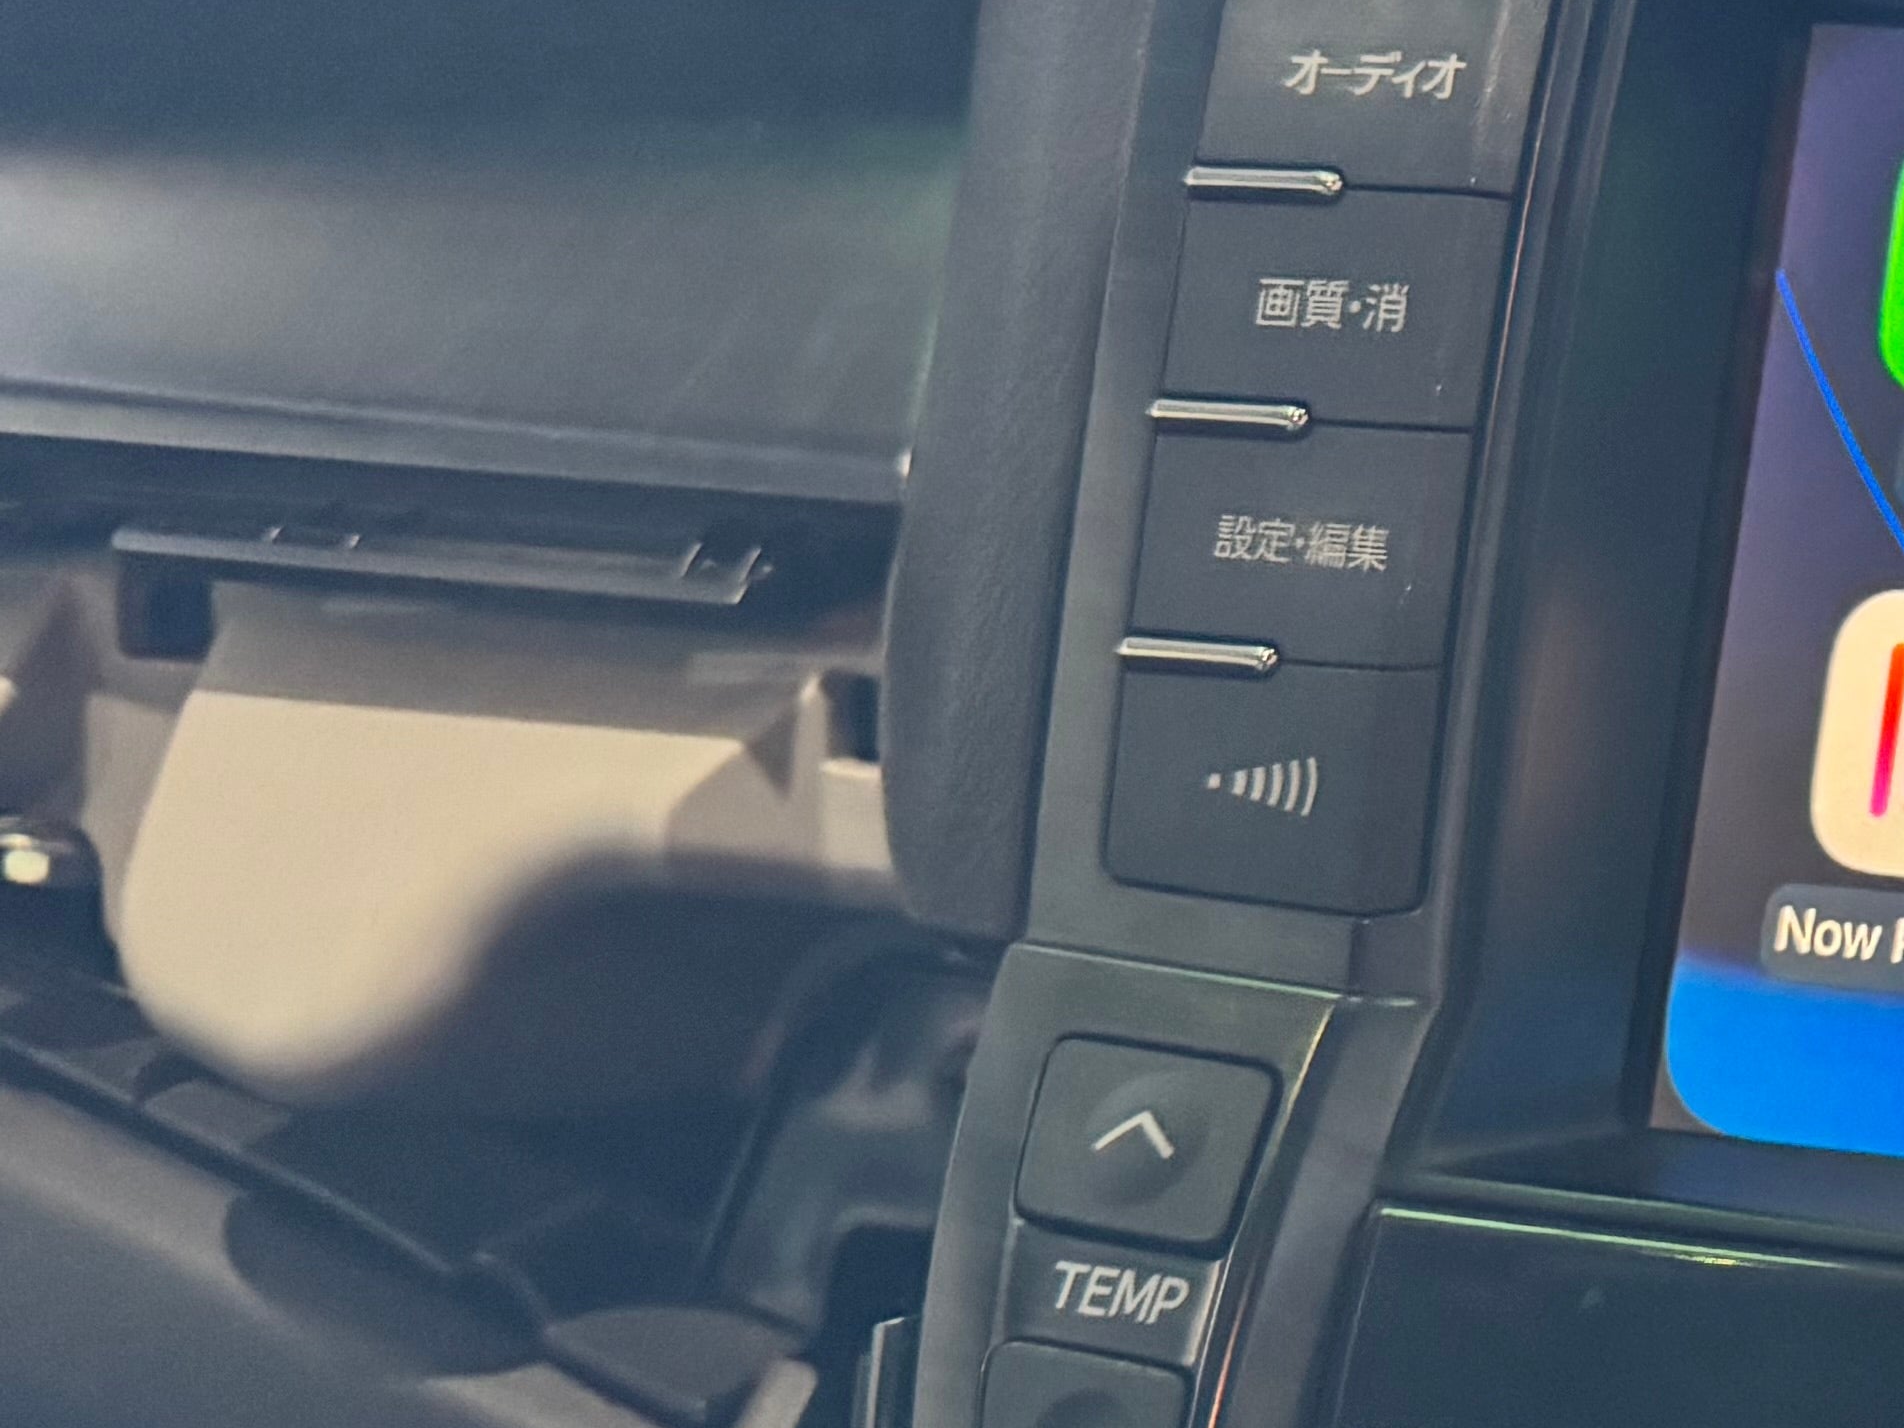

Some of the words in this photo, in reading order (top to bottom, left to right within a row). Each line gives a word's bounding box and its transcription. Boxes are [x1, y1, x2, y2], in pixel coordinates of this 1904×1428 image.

[1282, 48, 1467, 100] オーディオ
[1773, 904, 1882, 963] Now
[1054, 1259, 1190, 1325] TEMP
